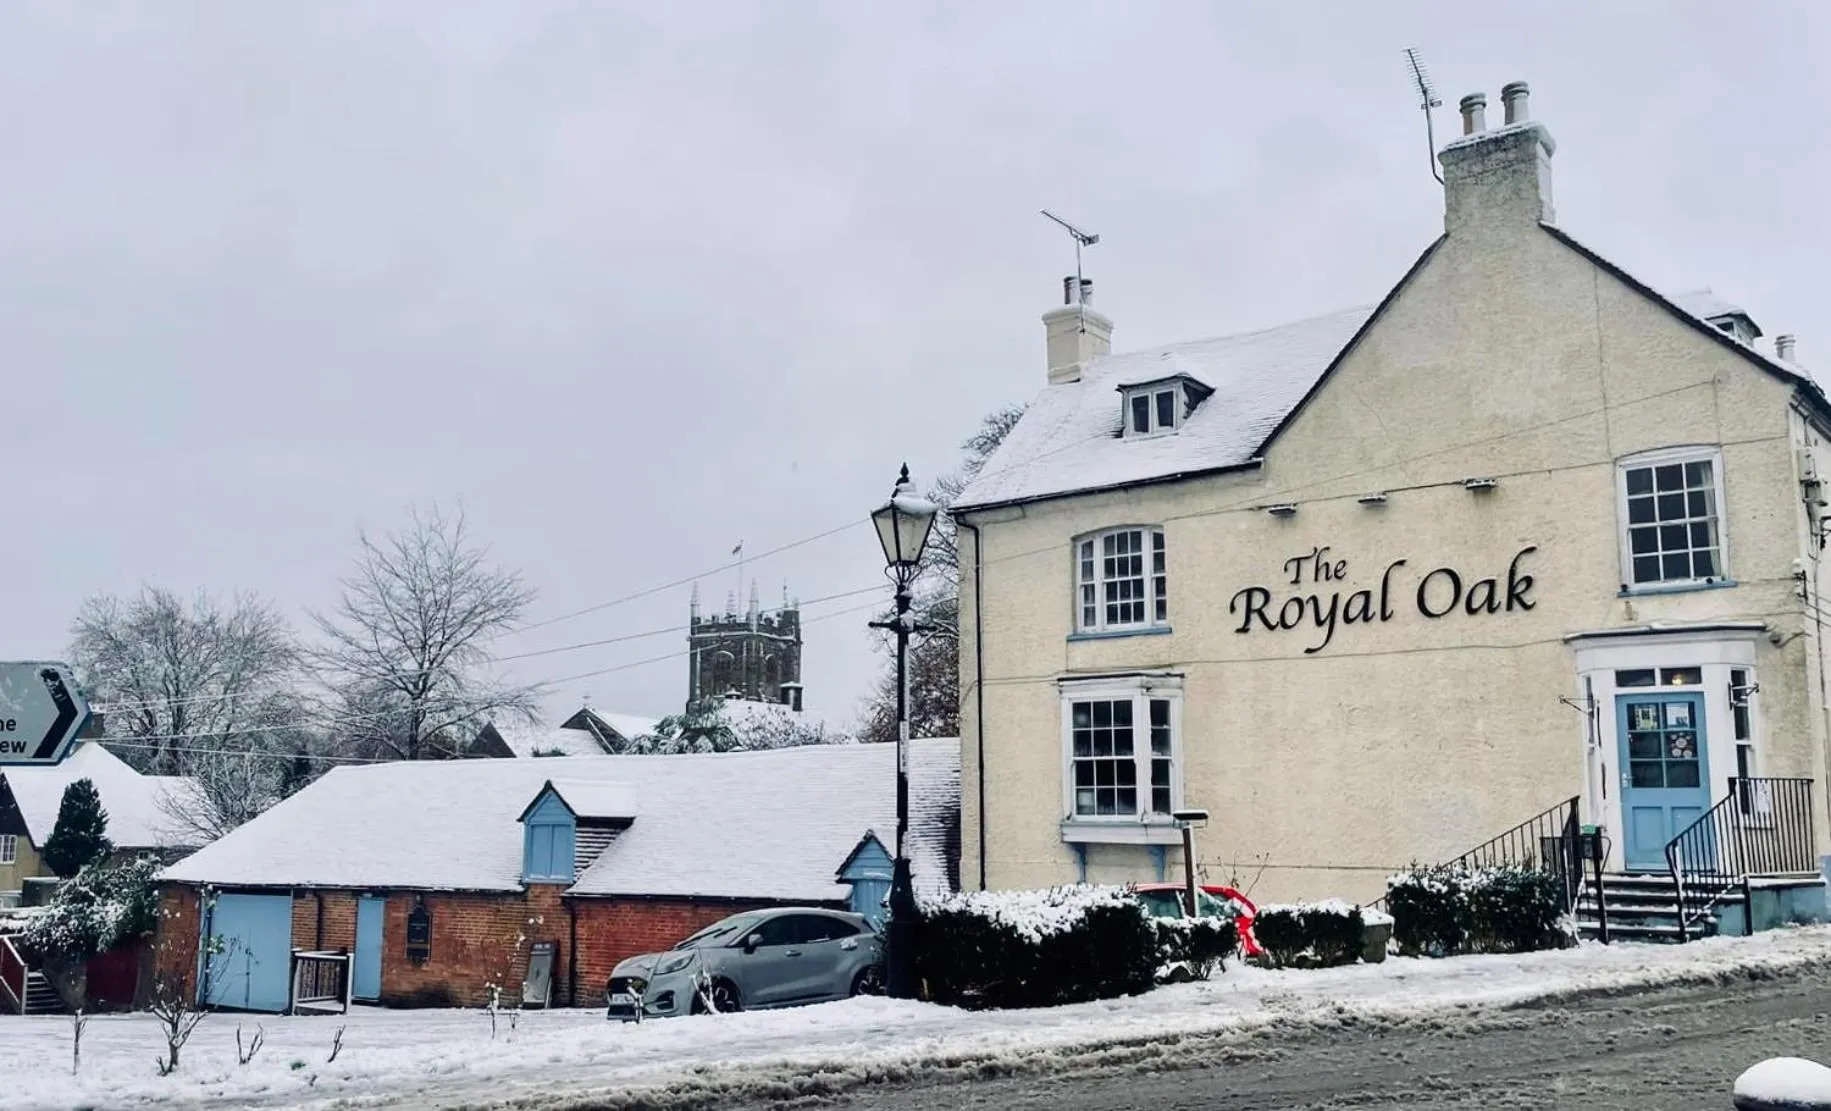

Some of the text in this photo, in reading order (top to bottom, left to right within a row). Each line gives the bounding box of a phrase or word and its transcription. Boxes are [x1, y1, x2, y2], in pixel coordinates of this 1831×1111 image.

[1230, 547, 1537, 653] Royal Oak
[1284, 547, 1347, 584] The
